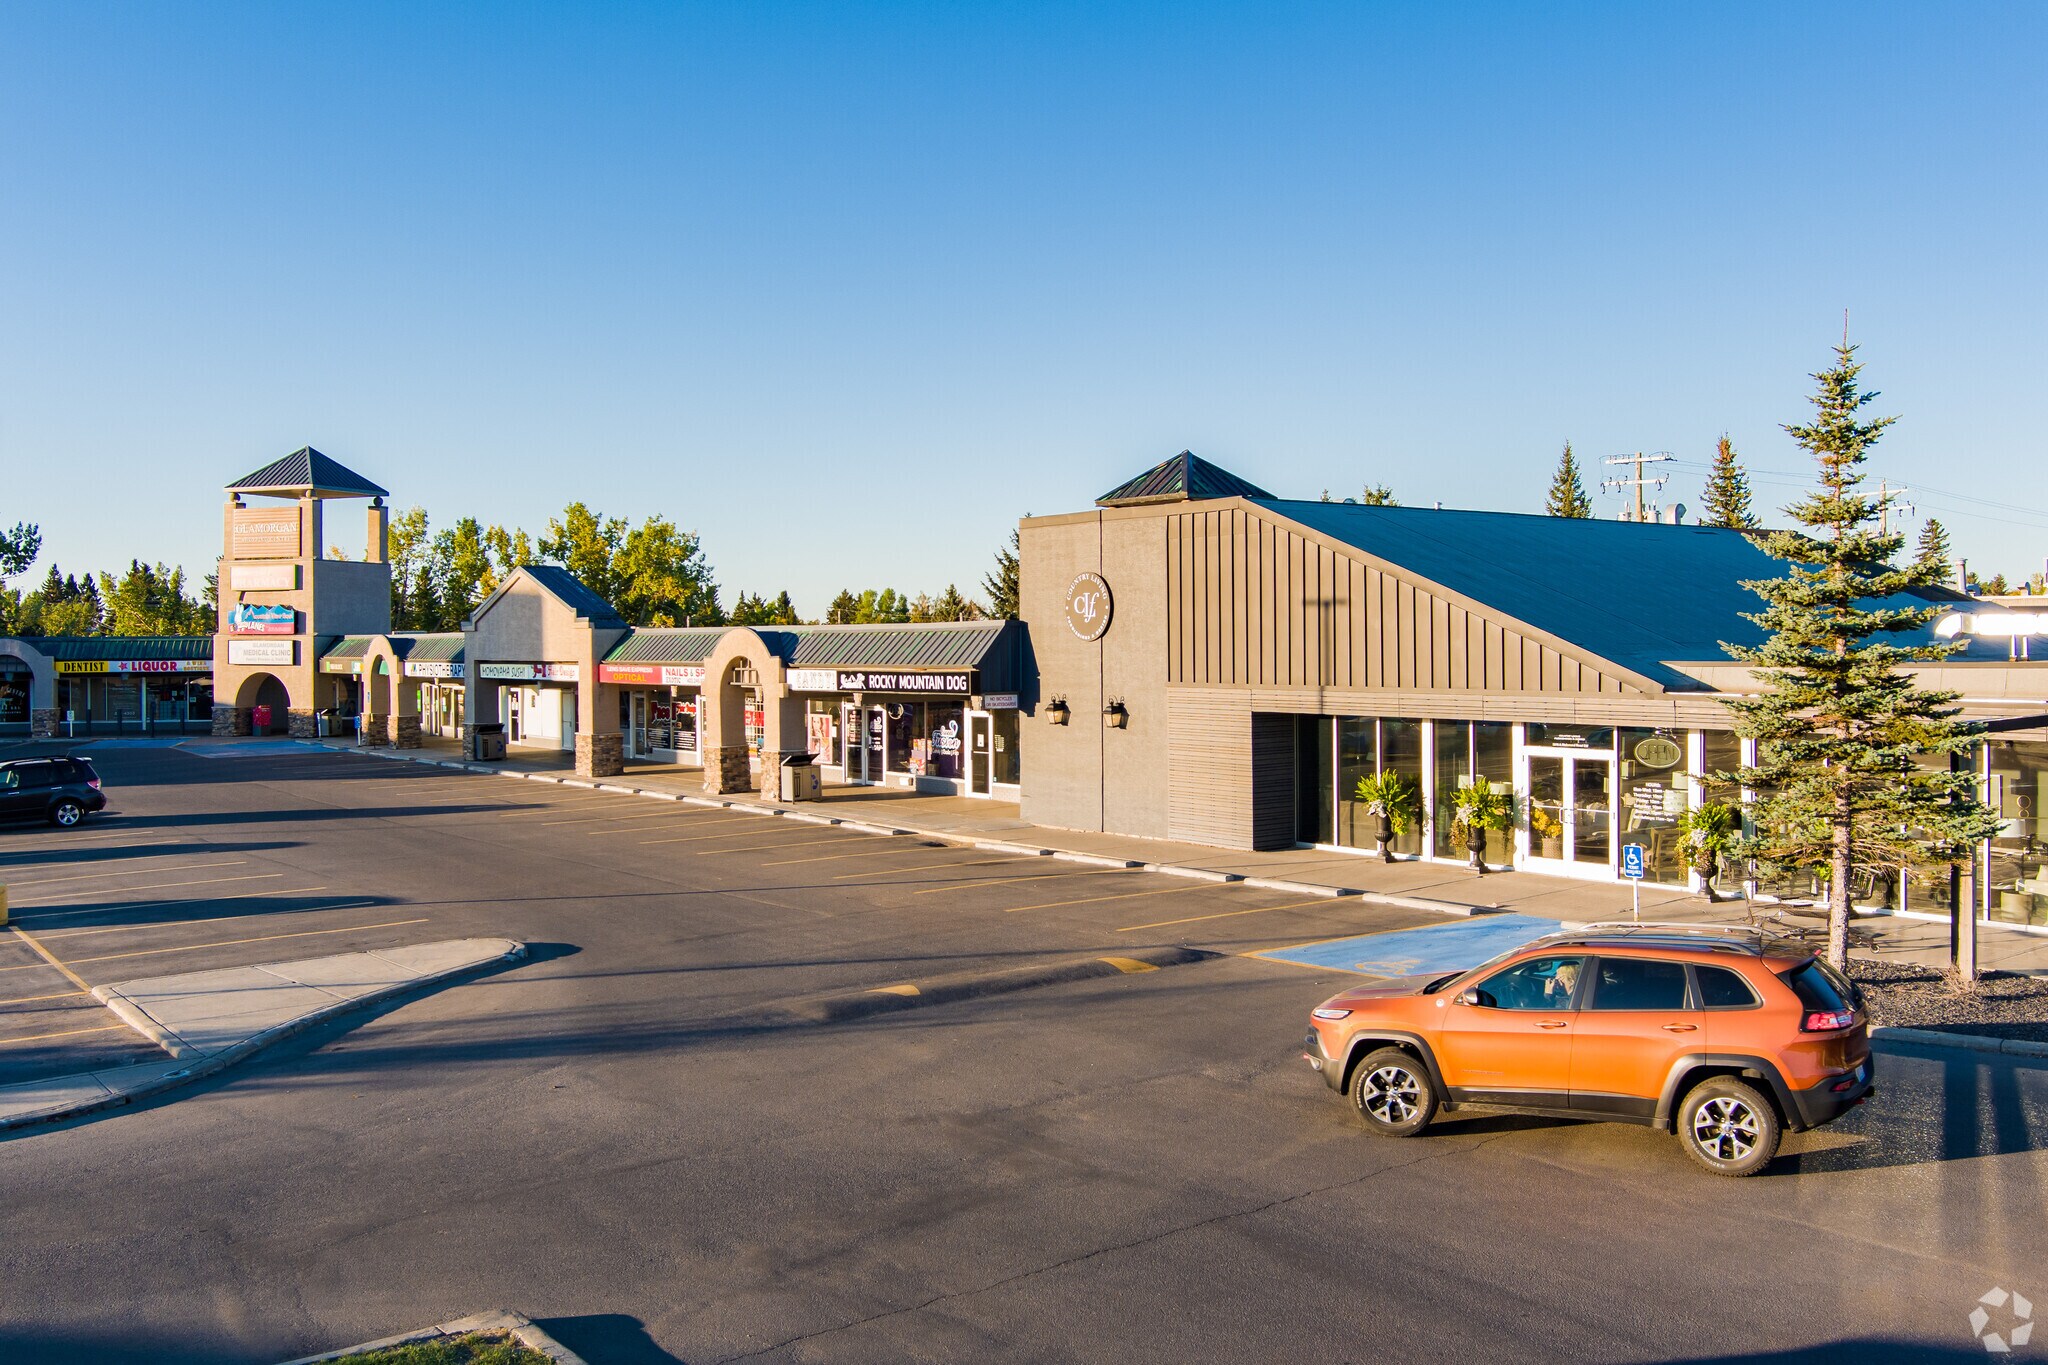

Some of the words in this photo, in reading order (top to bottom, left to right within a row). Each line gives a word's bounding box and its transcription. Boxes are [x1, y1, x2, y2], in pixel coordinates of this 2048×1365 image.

[235, 522, 297, 533] GLAMORGAN
[1066, 573, 1090, 601] COUNTRY
[1090, 574, 1108, 600] LIVING
[64, 661, 105, 672] DENTIST
[131, 661, 178, 671] LIQUOR
[419, 663, 465, 676] PHYSIOTHERAPY
[613, 673, 646, 681] OPTICAL
[665, 668, 688, 677] NAILS
[695, 668, 705, 677] SP
[868, 674, 896, 689] ROCKY
[899, 675, 944, 690] MOUNTAIN
[946, 675, 967, 690] DOG
[1638, 744, 1676, 761] OPEN
